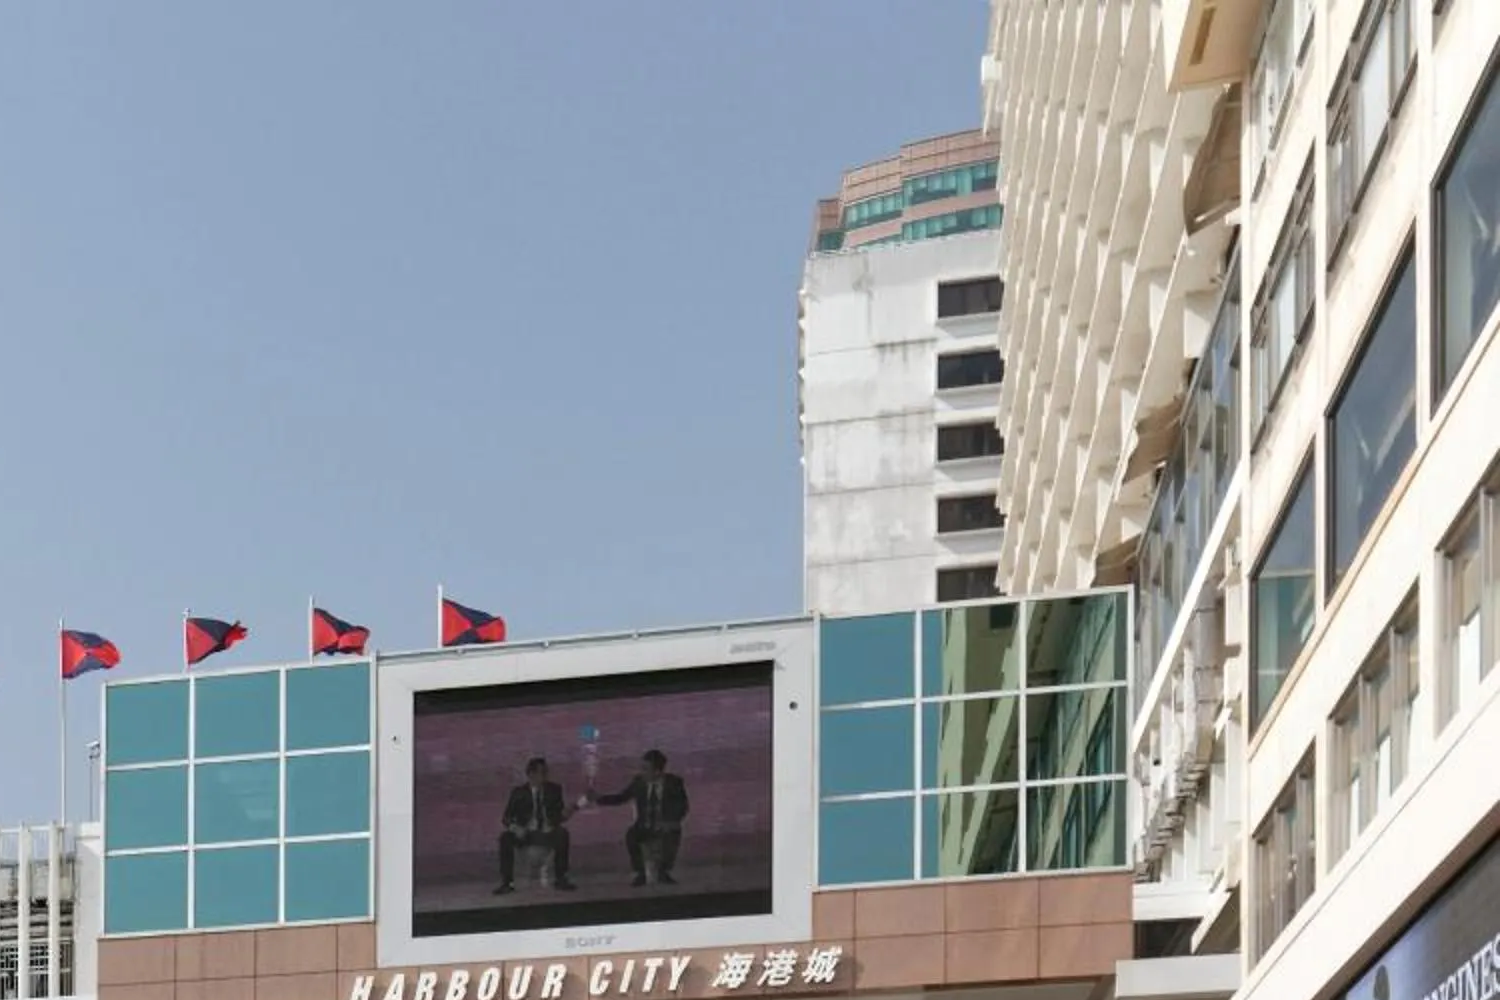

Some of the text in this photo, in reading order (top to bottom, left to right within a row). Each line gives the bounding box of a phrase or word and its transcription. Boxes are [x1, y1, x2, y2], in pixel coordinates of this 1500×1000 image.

[588, 955, 692, 996] CITY
[711, 944, 843, 989] 海港城
